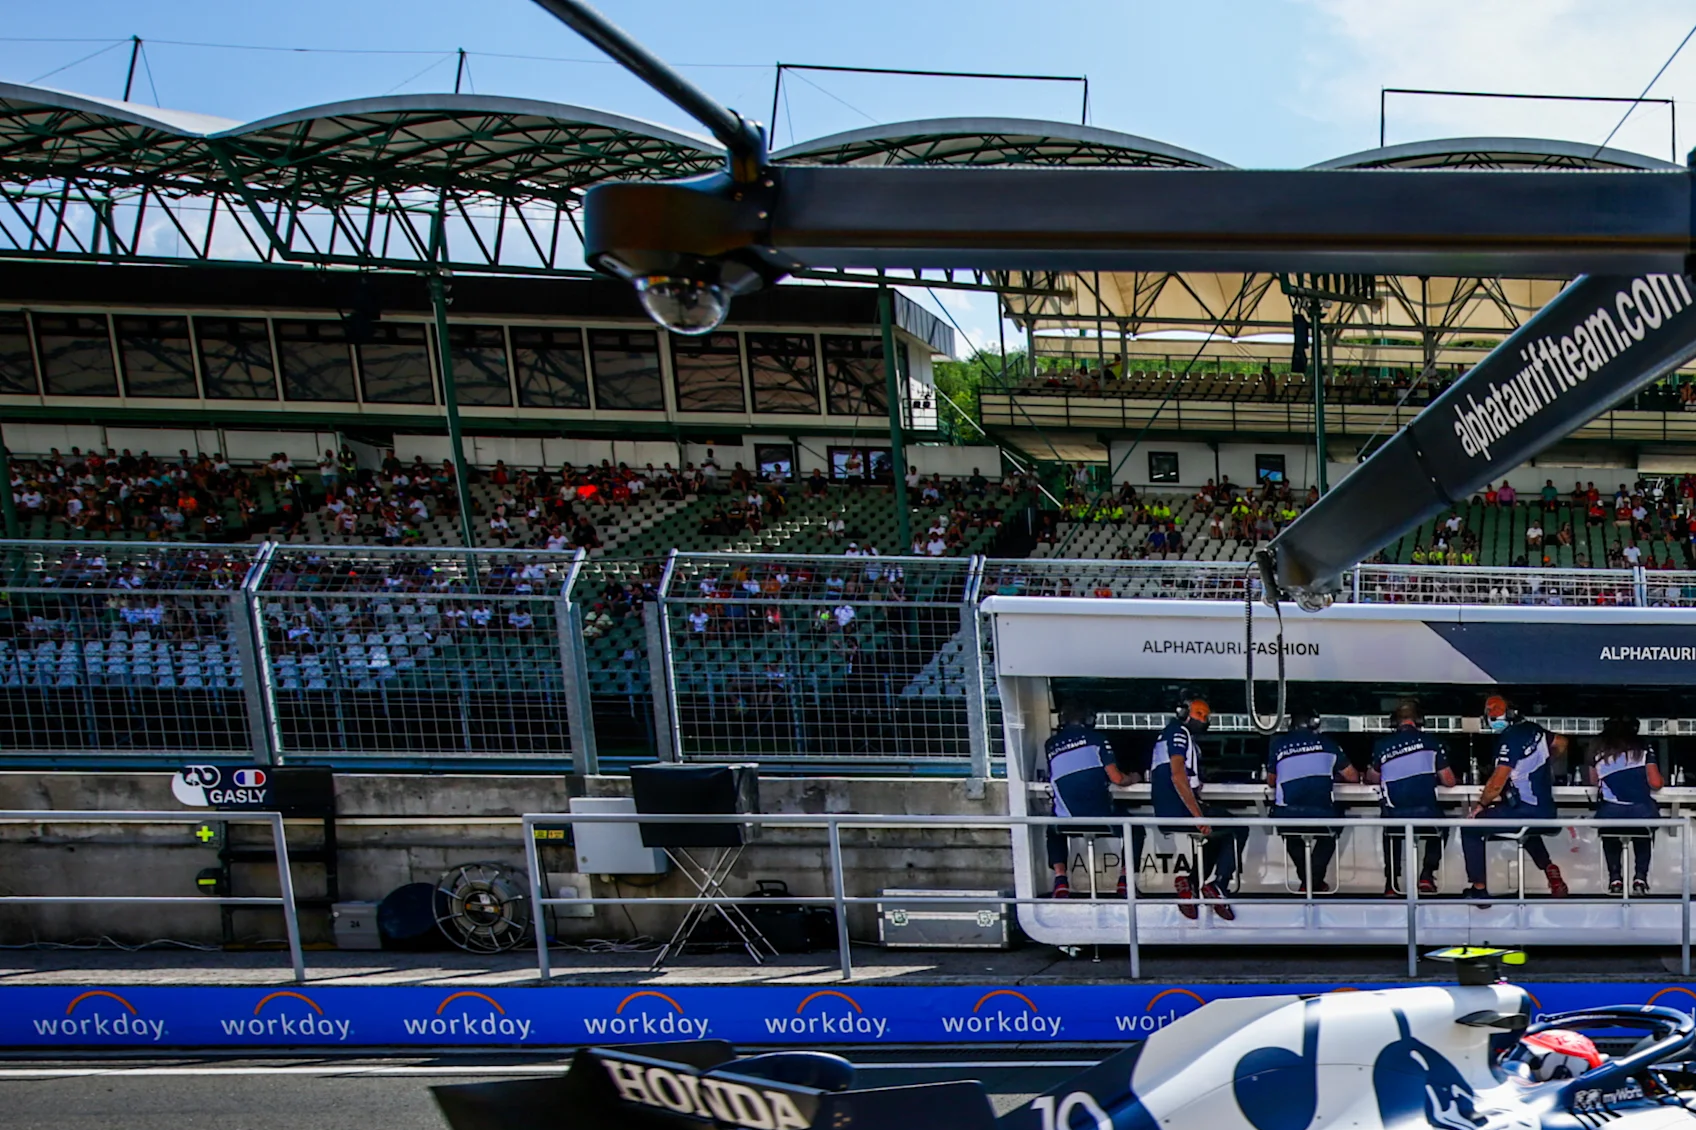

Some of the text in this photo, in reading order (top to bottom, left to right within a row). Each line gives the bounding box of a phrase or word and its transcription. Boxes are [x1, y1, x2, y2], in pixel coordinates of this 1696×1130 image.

[210, 789, 267, 804] GASLY
[33, 1012, 164, 1040] workday
[222, 1012, 350, 1040] workday
[404, 1011, 532, 1039] workday
[584, 1011, 709, 1038] workday
[765, 1011, 887, 1038] workday
[942, 1010, 1061, 1037] workday
